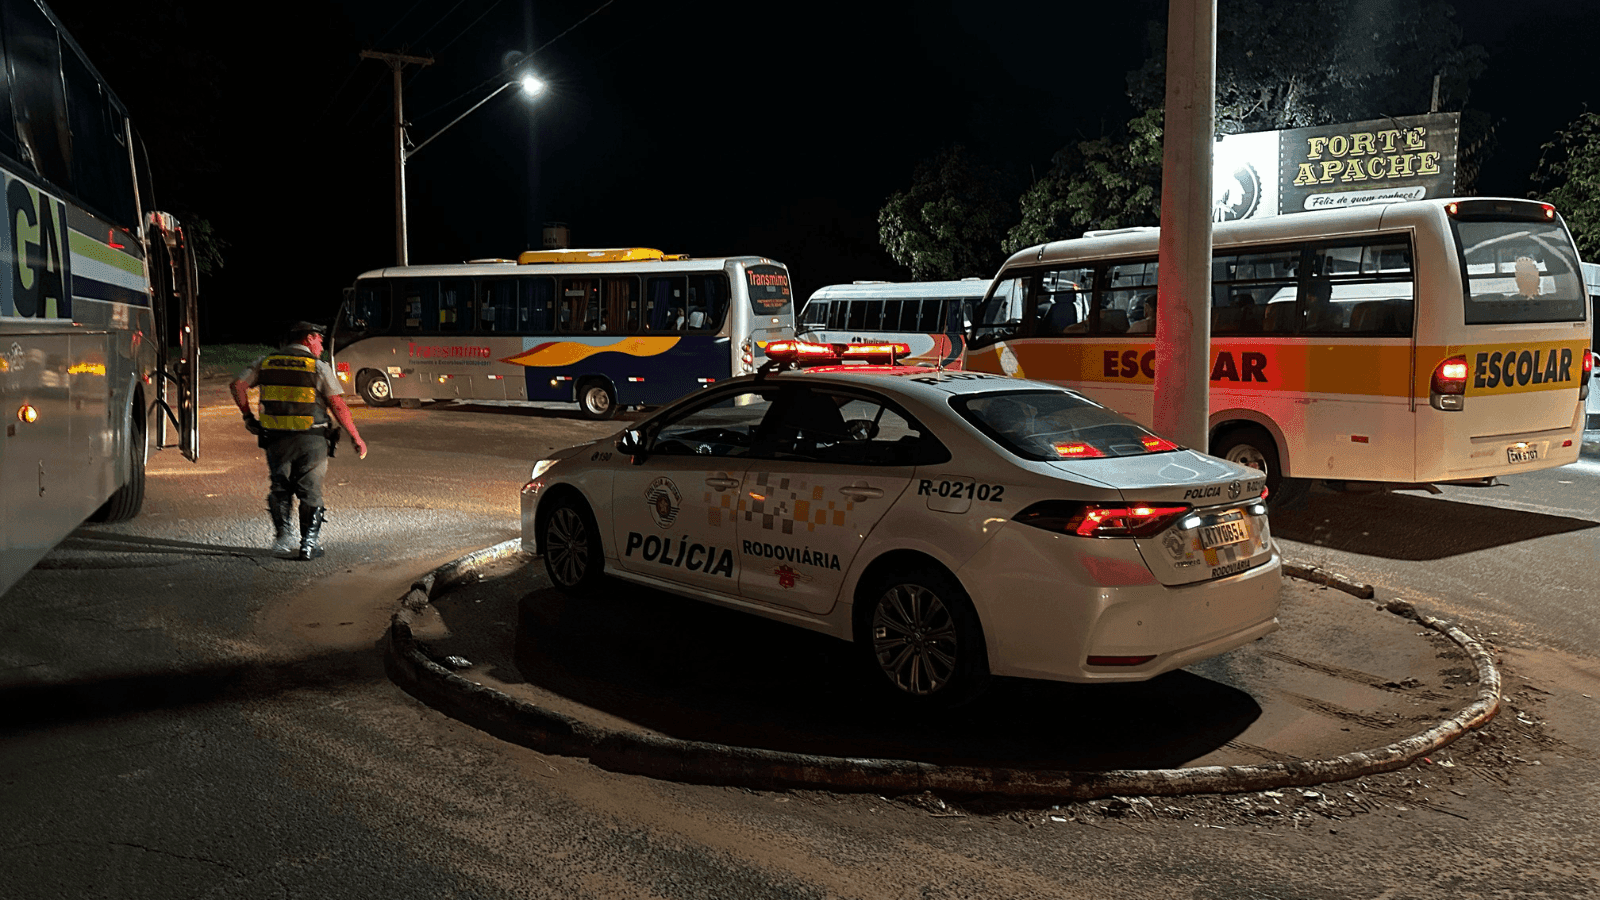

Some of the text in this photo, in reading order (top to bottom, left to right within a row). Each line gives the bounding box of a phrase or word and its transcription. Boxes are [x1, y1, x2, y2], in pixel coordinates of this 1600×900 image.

[1307, 127, 1426, 160] FORTE
[1293, 151, 1440, 186] APACHE
[1312, 197, 1334, 207] Feliz
[1337, 196, 1348, 204] de
[1350, 195, 1374, 204] quem
[408, 341, 491, 359] Transmimo
[1473, 348, 1573, 389] ESCOLAR
[917, 479, 1005, 503] R-02102
[625, 531, 735, 579] POLÍCIA
[742, 539, 842, 571] RODOVIÁRIA
